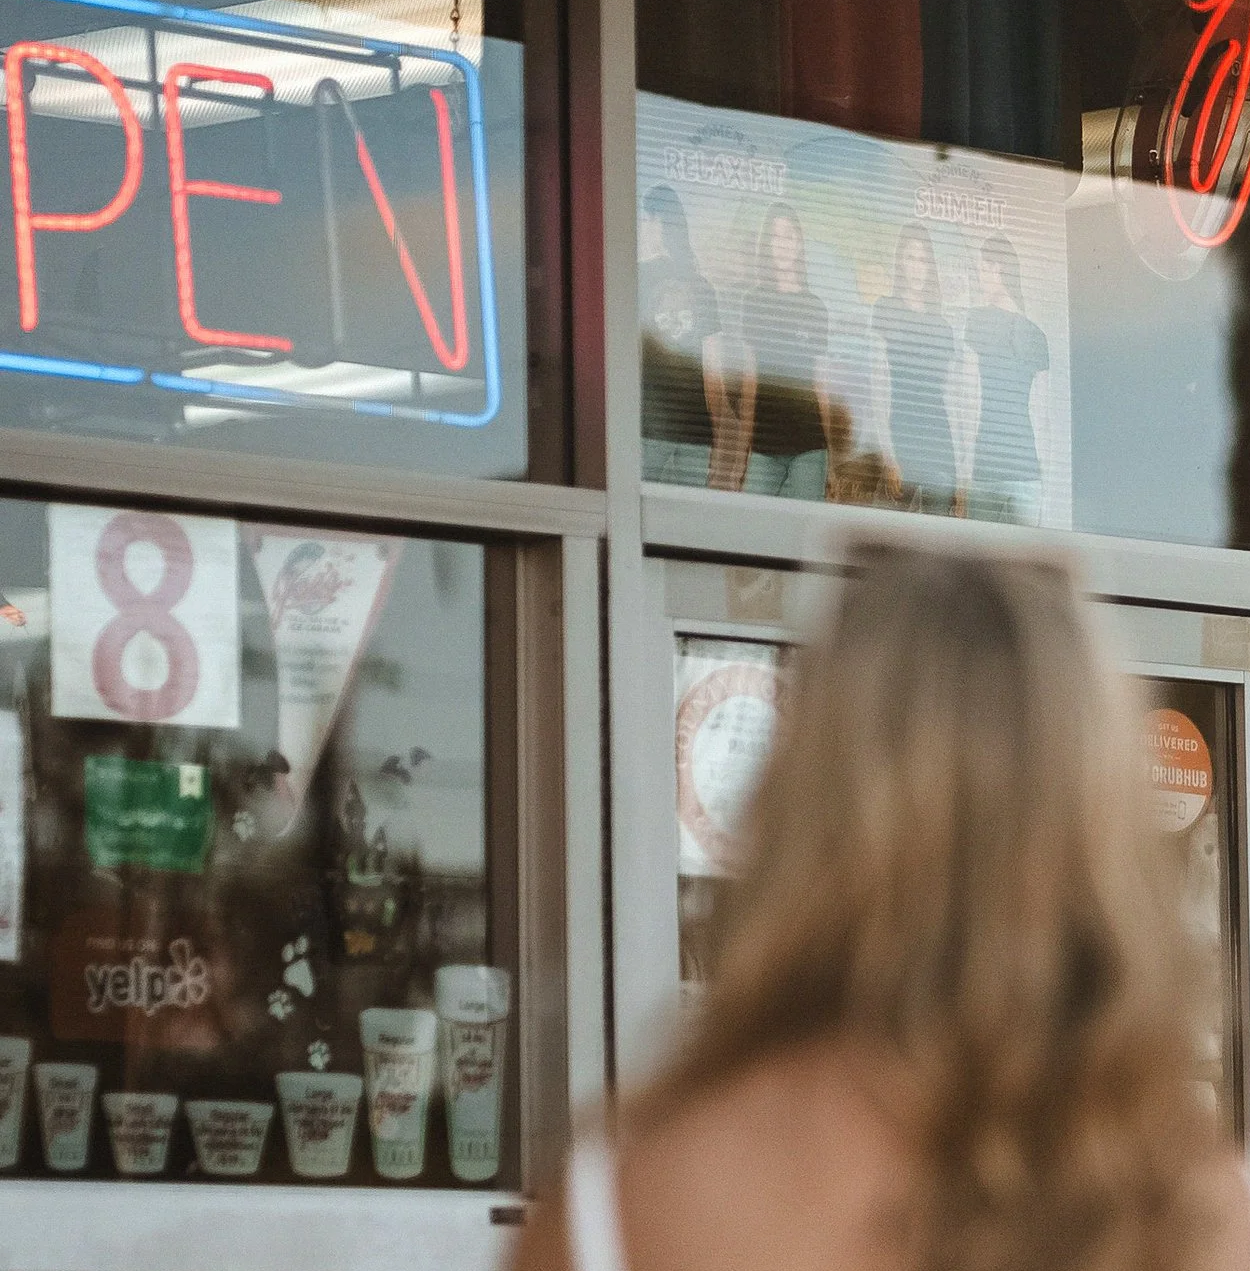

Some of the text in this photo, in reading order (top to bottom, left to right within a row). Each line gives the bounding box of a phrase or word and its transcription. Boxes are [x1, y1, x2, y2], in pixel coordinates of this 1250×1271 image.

[748, 158, 787, 195] FIT
[5, 41, 469, 369] PEN
[914, 186, 1007, 229] SLIM FIT
[94, 511, 199, 719] 8
[1152, 765, 1208, 789] GRUBHUB
[84, 956, 168, 1017] yelp
